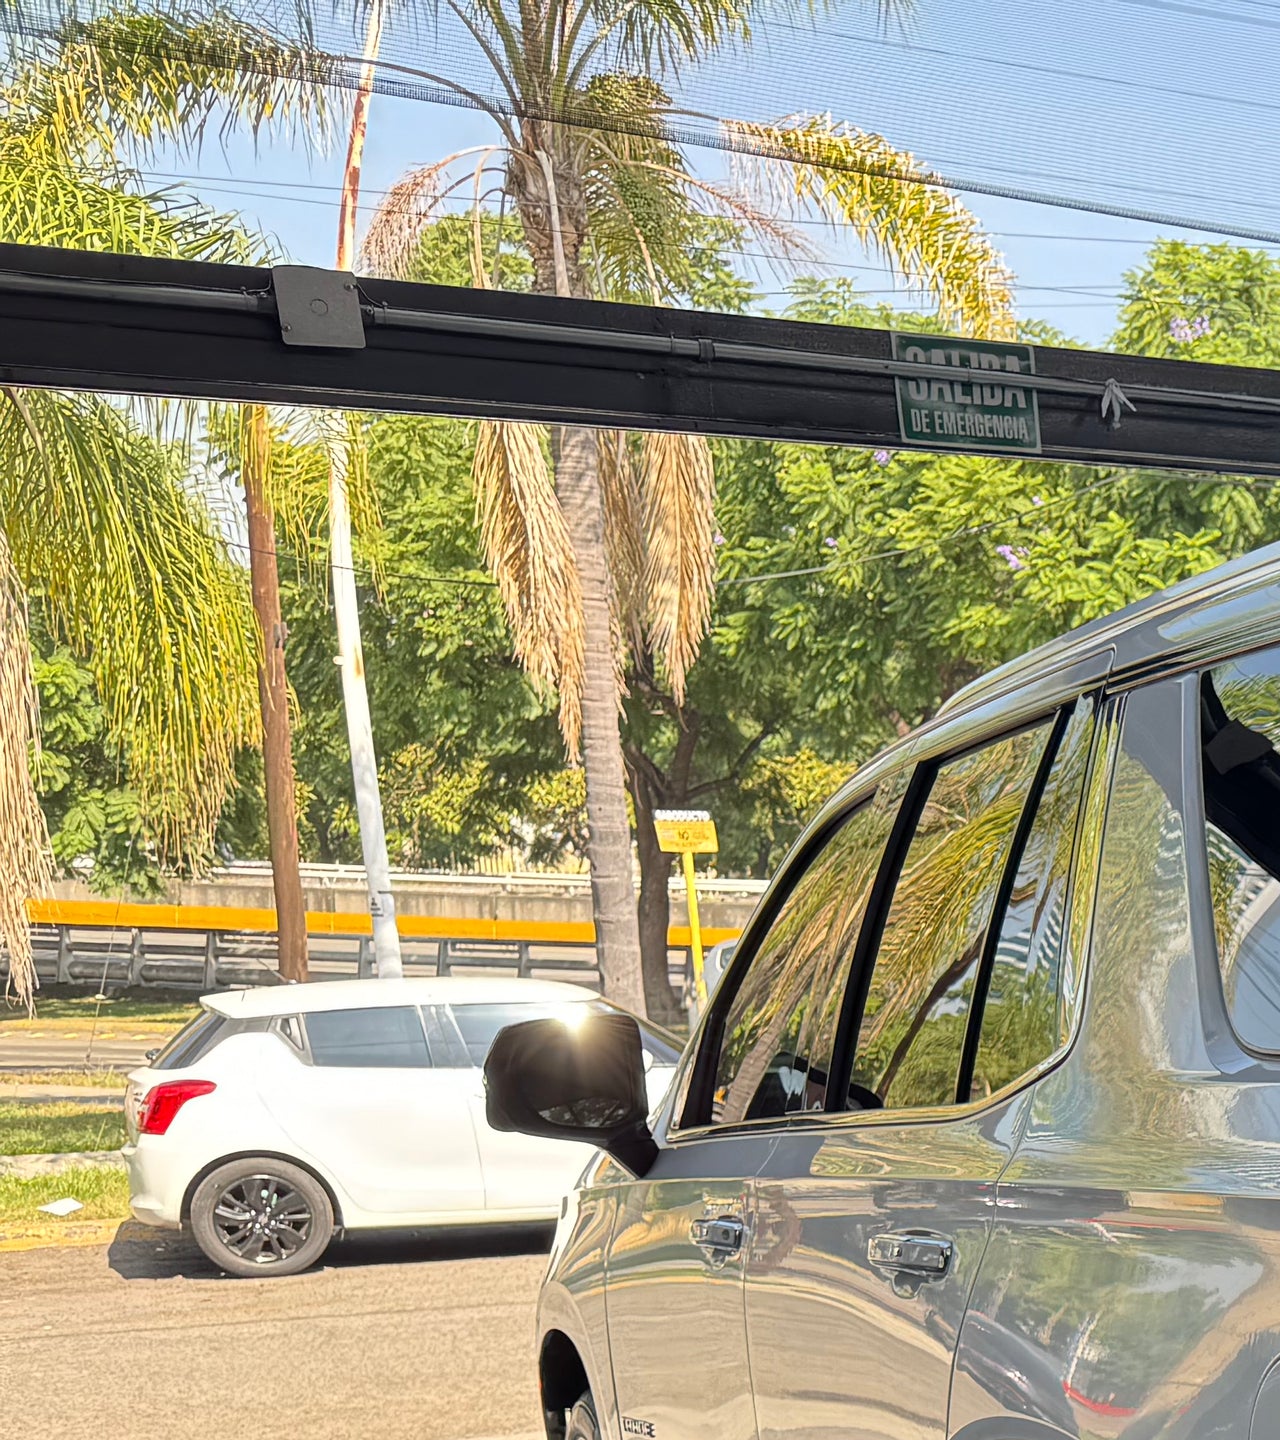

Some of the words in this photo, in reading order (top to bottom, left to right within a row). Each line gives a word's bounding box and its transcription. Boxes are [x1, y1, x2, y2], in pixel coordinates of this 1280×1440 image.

[905, 346, 1027, 408] SALIDA
[911, 409, 930, 433] DE
[934, 410, 1030, 440] EMERGENCIA
